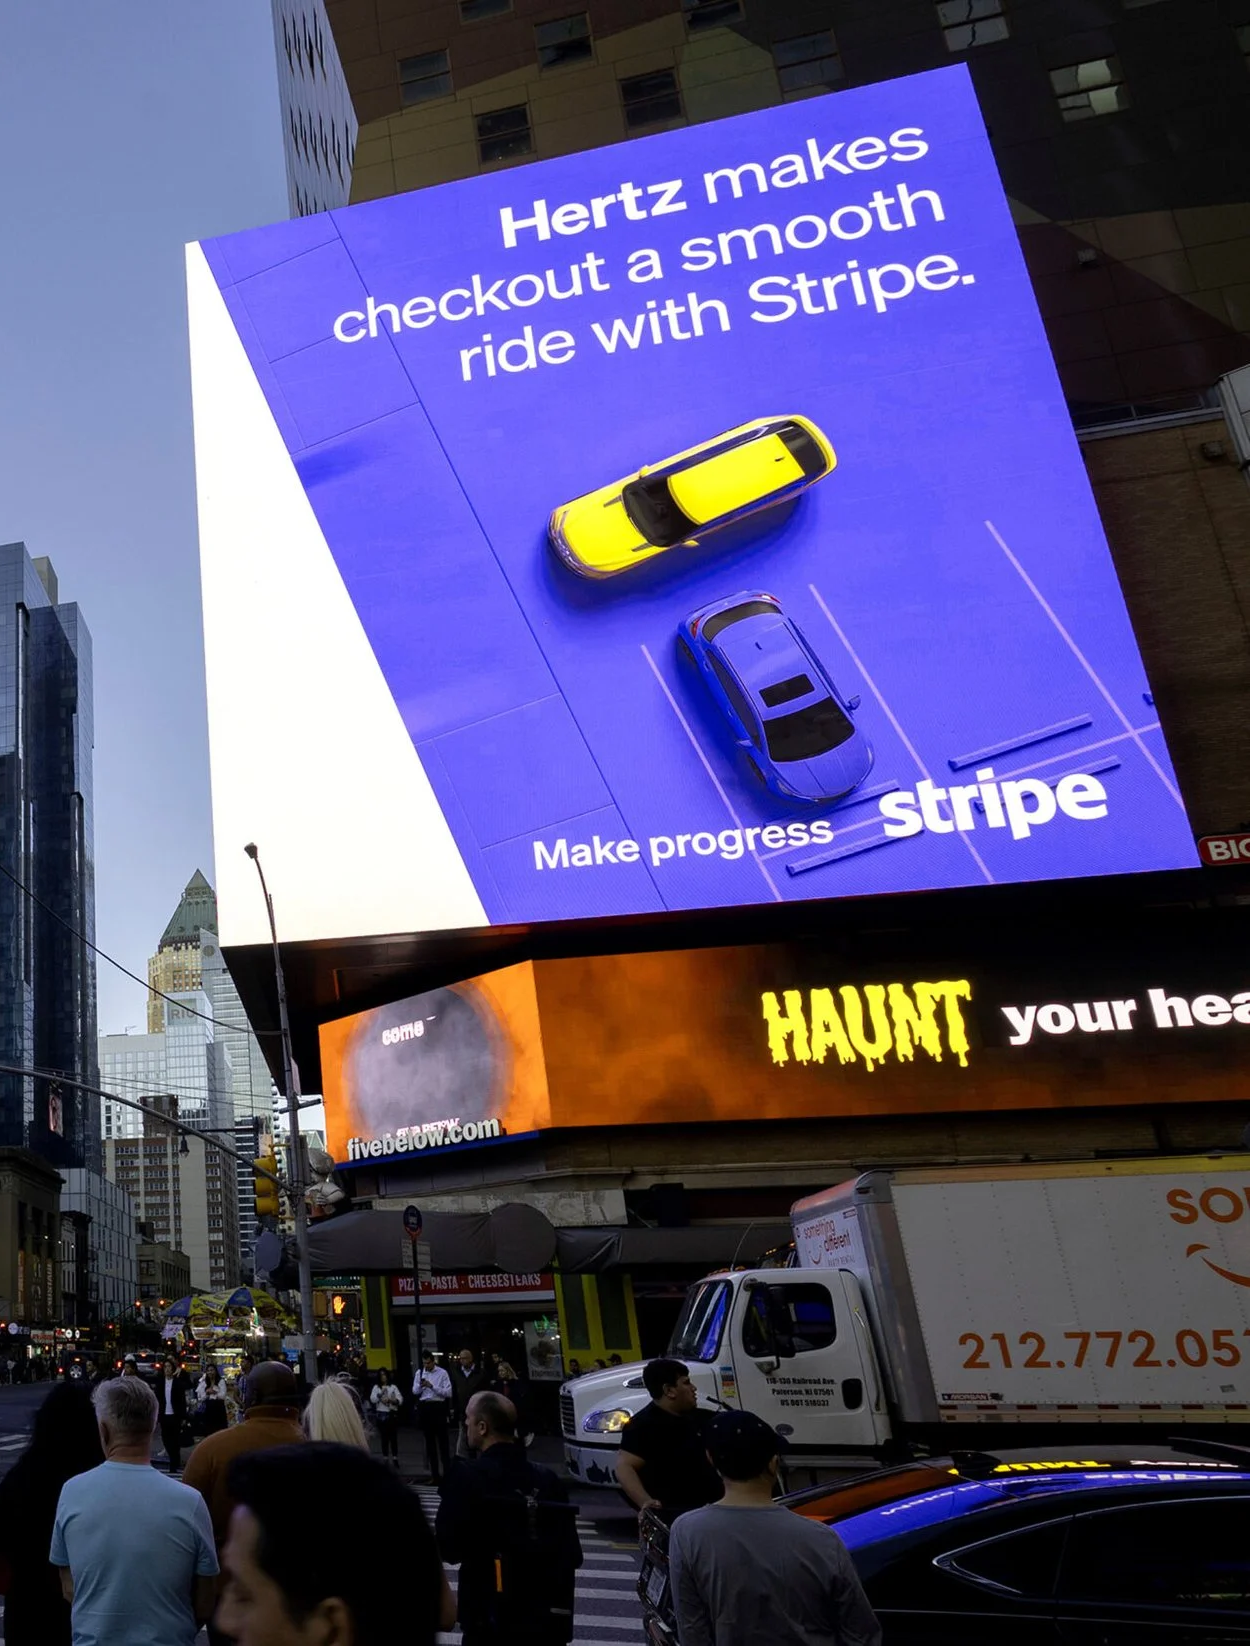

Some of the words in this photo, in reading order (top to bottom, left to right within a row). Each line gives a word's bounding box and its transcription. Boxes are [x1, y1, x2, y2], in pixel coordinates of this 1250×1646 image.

[500, 180, 687, 248] Hertz
[704, 128, 928, 203] makes
[334, 253, 610, 342] checkout
[628, 249, 664, 283] a
[682, 184, 944, 271] smooth
[461, 326, 576, 382] ride
[591, 293, 731, 353] with
[749, 255, 974, 322] Stripe.
[534, 836, 639, 869] Make
[650, 821, 834, 866] progress
[879, 768, 1108, 839] stripe
[761, 979, 972, 1072] HAUNT
[1000, 999, 1138, 1046] your
[347, 1118, 500, 1161] fivebelow.com
[1166, 1187, 1250, 1225] SO
[431, 1275, 459, 1290] PASTA
[468, 1273, 542, 1290] CHEESESTEAKS
[958, 1329, 1250, 1369] 212.772.05
